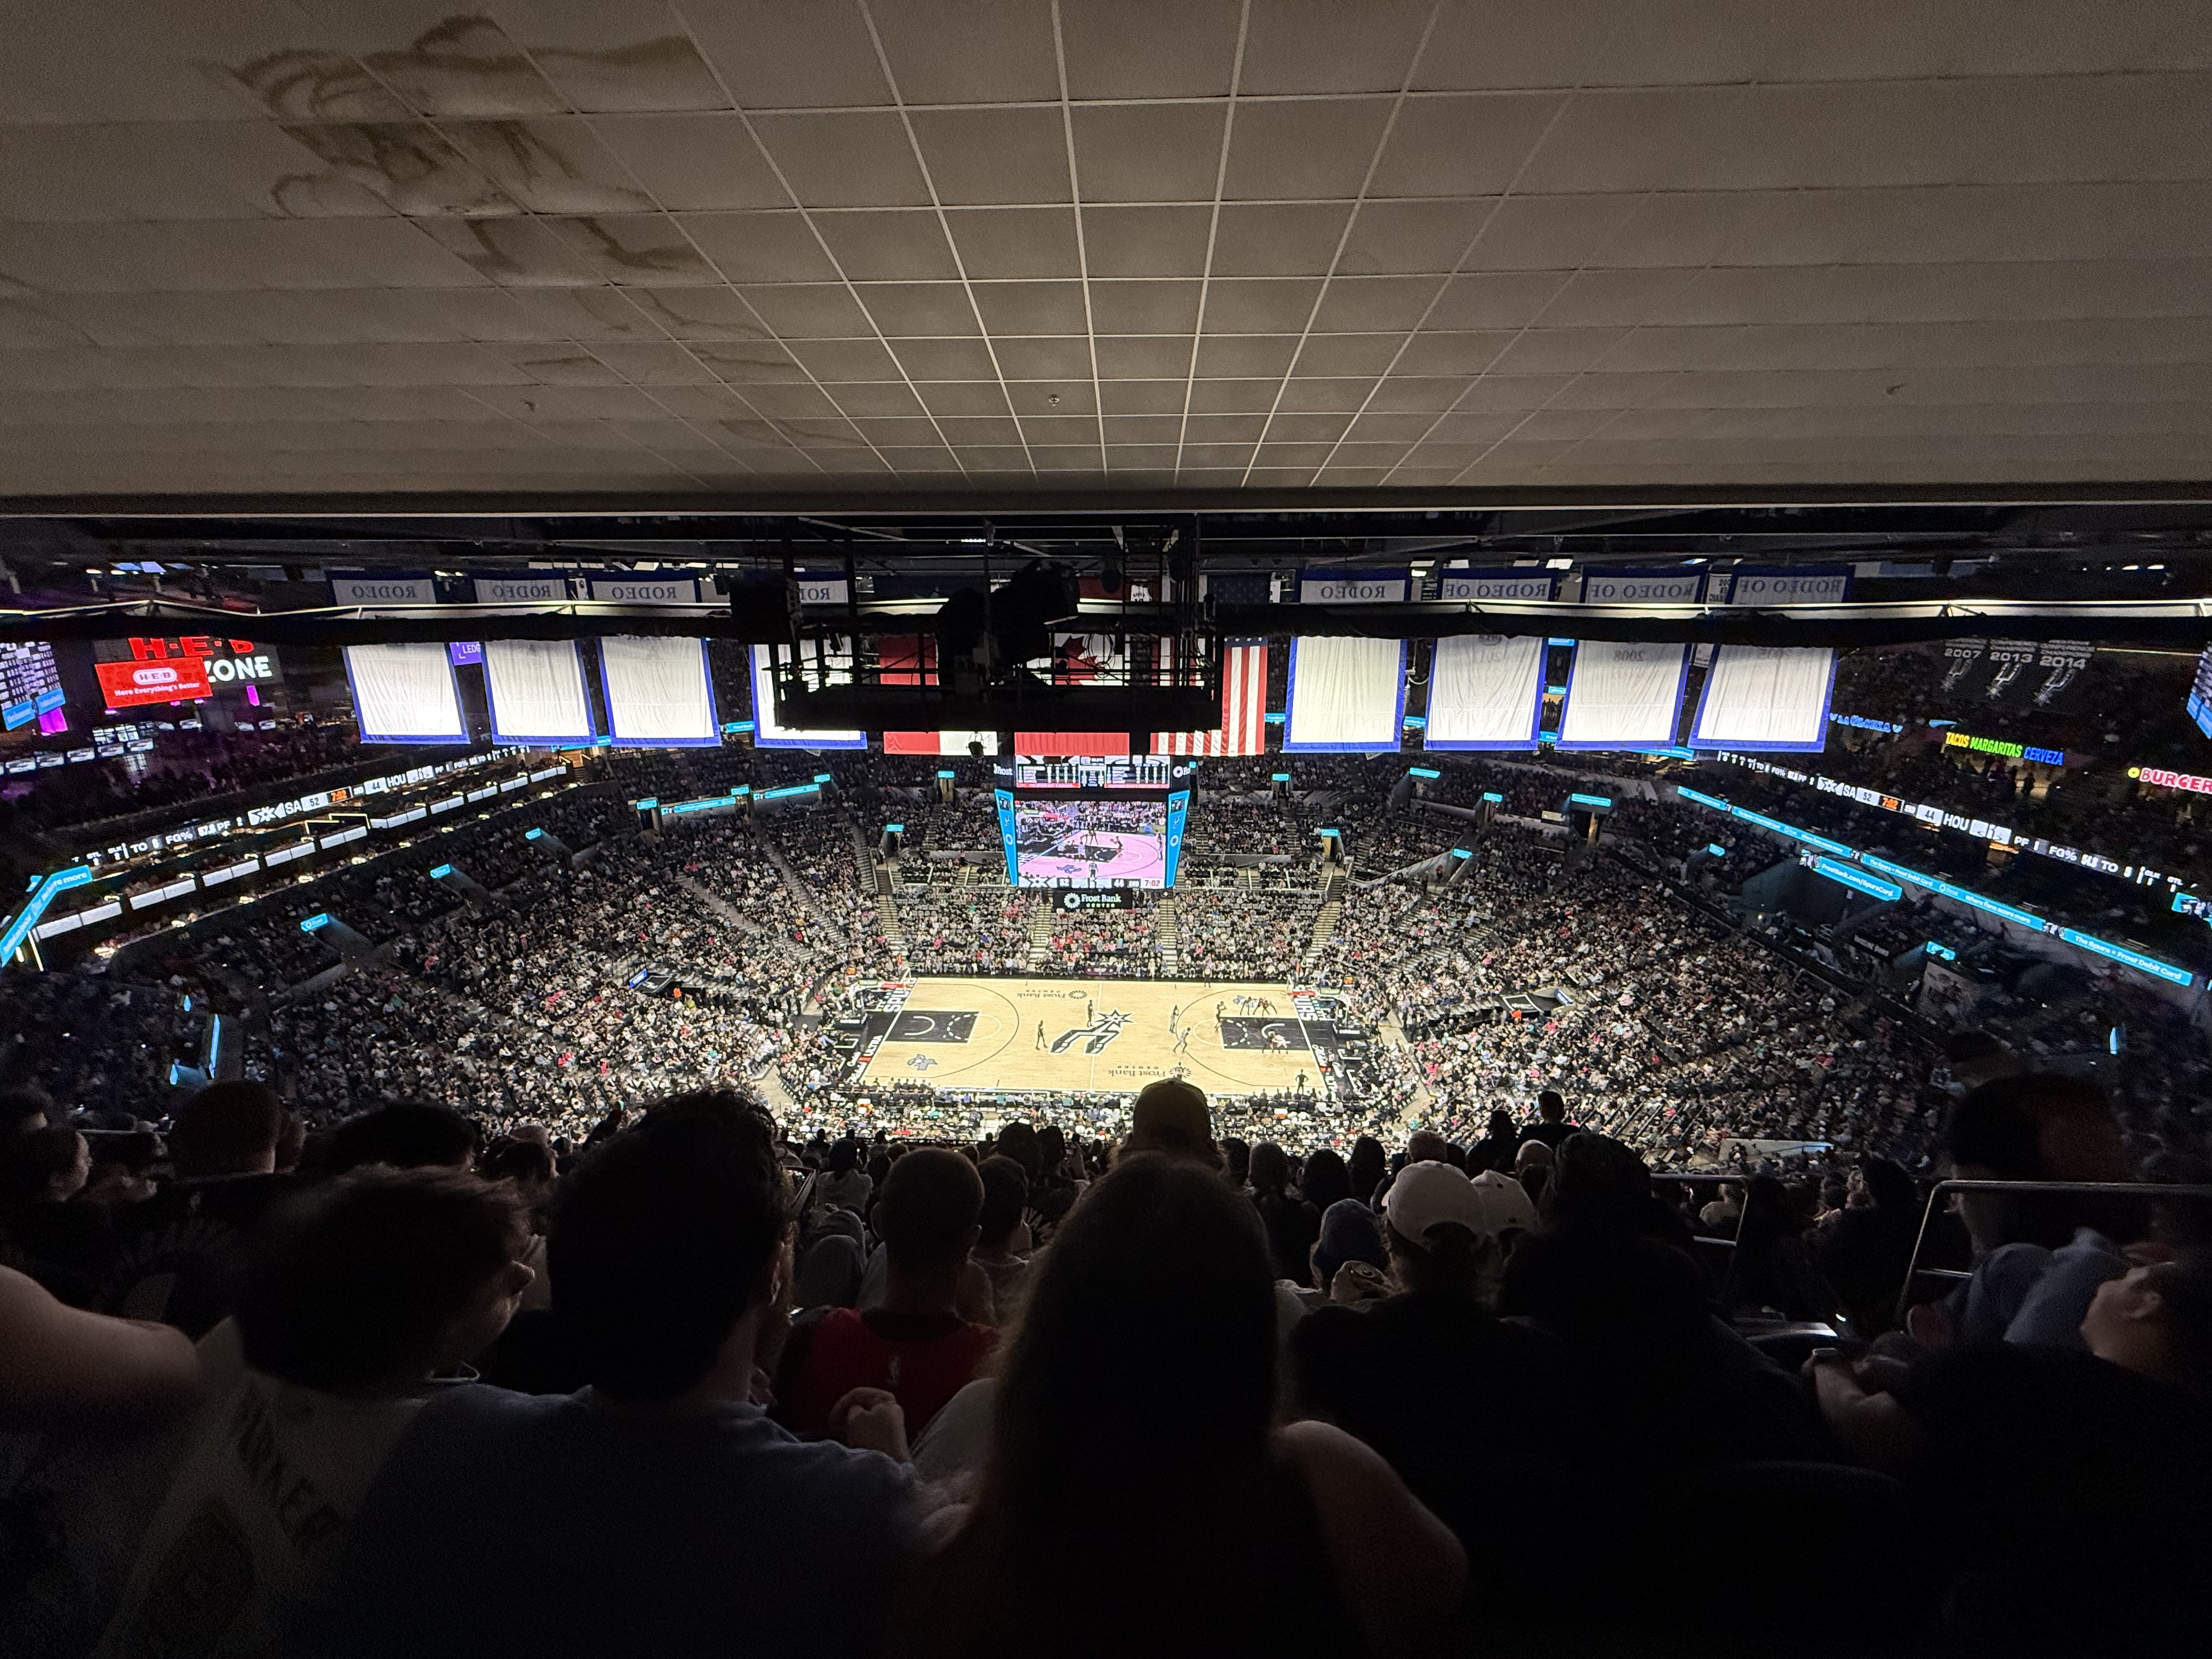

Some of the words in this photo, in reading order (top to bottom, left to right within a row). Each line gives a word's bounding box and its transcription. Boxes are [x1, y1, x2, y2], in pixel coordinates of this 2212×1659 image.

[1944, 648, 1982, 658] 2007
[1990, 651, 2033, 663] 2013
[2039, 656, 2087, 669] 2014
[1946, 731, 1970, 748] TACOS
[1970, 737, 2023, 758] MARGARITAS
[2023, 747, 2064, 766] CERVEZA
[386, 773, 406, 787] HOU
[2140, 767, 2212, 795] BURGER
[371, 782, 381, 791] 44
[1842, 785, 1857, 799] SA
[309, 797, 319, 807] 52
[1863, 791, 1872, 802] 52
[285, 800, 302, 814] SA
[1924, 809, 1935, 821] 44
[1943, 812, 1970, 831] HOU
[165, 831, 193, 845] FG%
[2013, 836, 2030, 847] PF
[130, 842, 148, 854] TO
[2049, 845, 2078, 862] FG%
[2101, 860, 2119, 873] TO
[63, 872, 88, 883] more
[1144, 879, 1161, 888] 7:02
[1081, 893, 1101, 903] Frost
[1101, 893, 1122, 903] Bank
[1965, 894, 1983, 905] Where
[1983, 900, 1997, 911] fans
[2014, 912, 2031, 924] more
[2074, 934, 2089, 946] The
[2088, 940, 2111, 954] Spurs
[2117, 951, 2138, 964] Frost
[2138, 958, 2160, 972] Debit
[2160, 966, 2182, 980] Card
[1108, 1069, 1136, 1077] Bank
[1138, 1069, 1166, 1077] Frost
